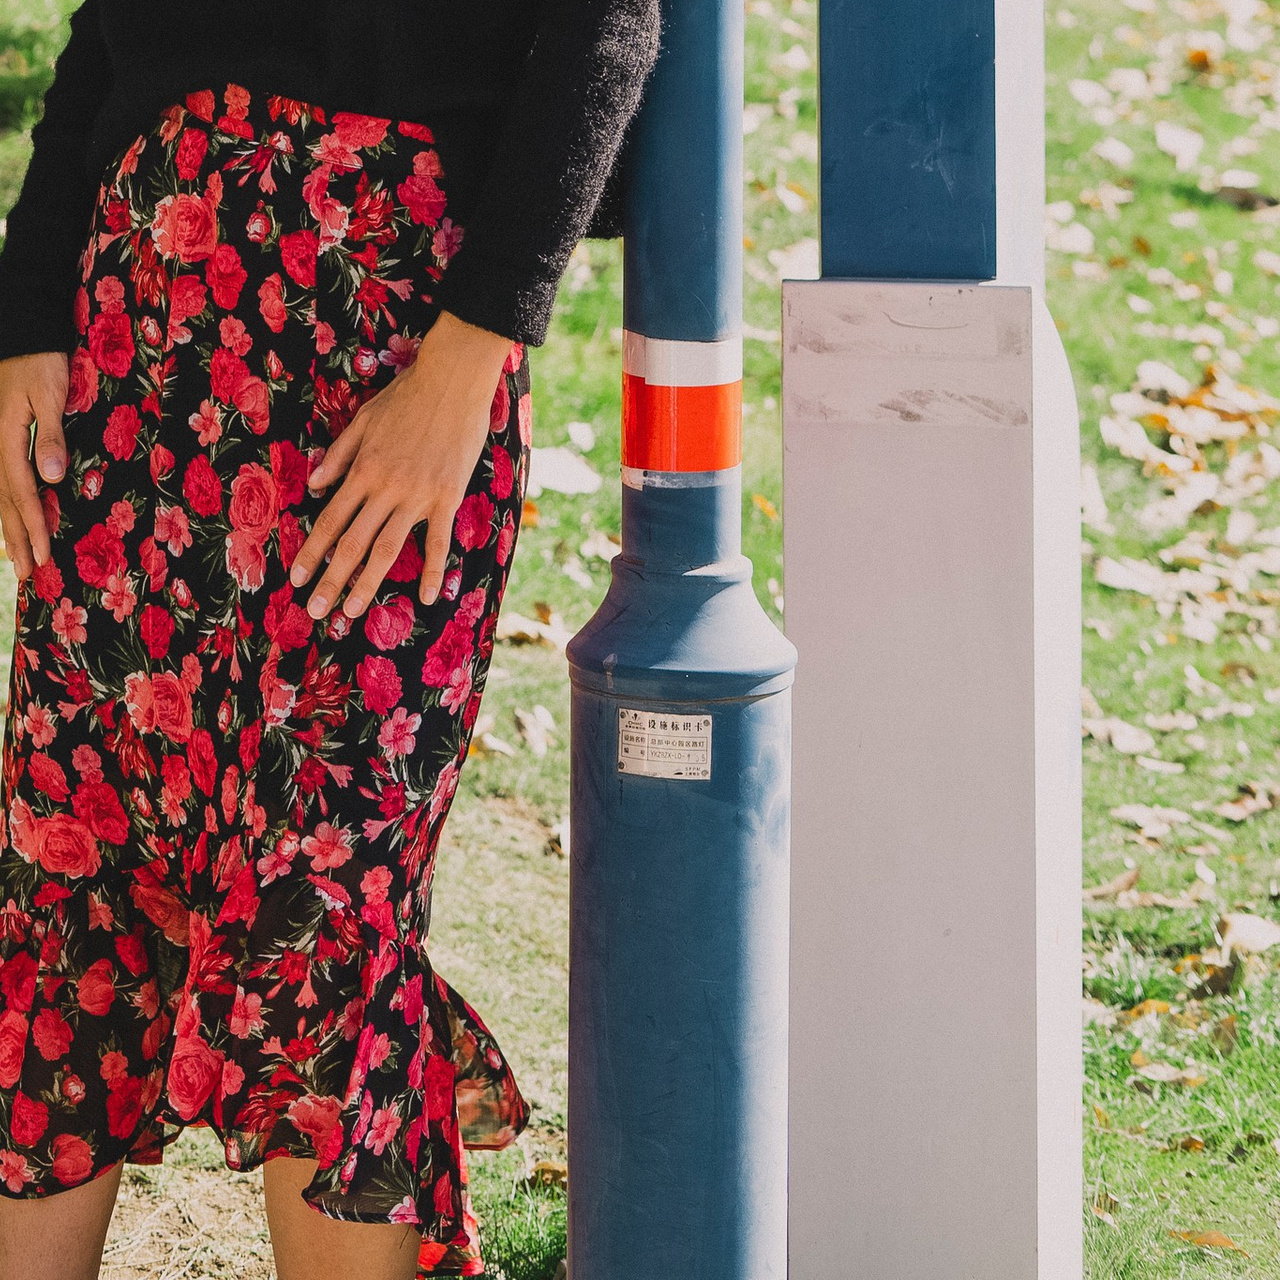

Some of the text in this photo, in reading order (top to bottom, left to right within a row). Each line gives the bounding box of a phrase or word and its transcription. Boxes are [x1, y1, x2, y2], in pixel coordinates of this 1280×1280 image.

[648, 719, 703, 732] 设施标识卡
